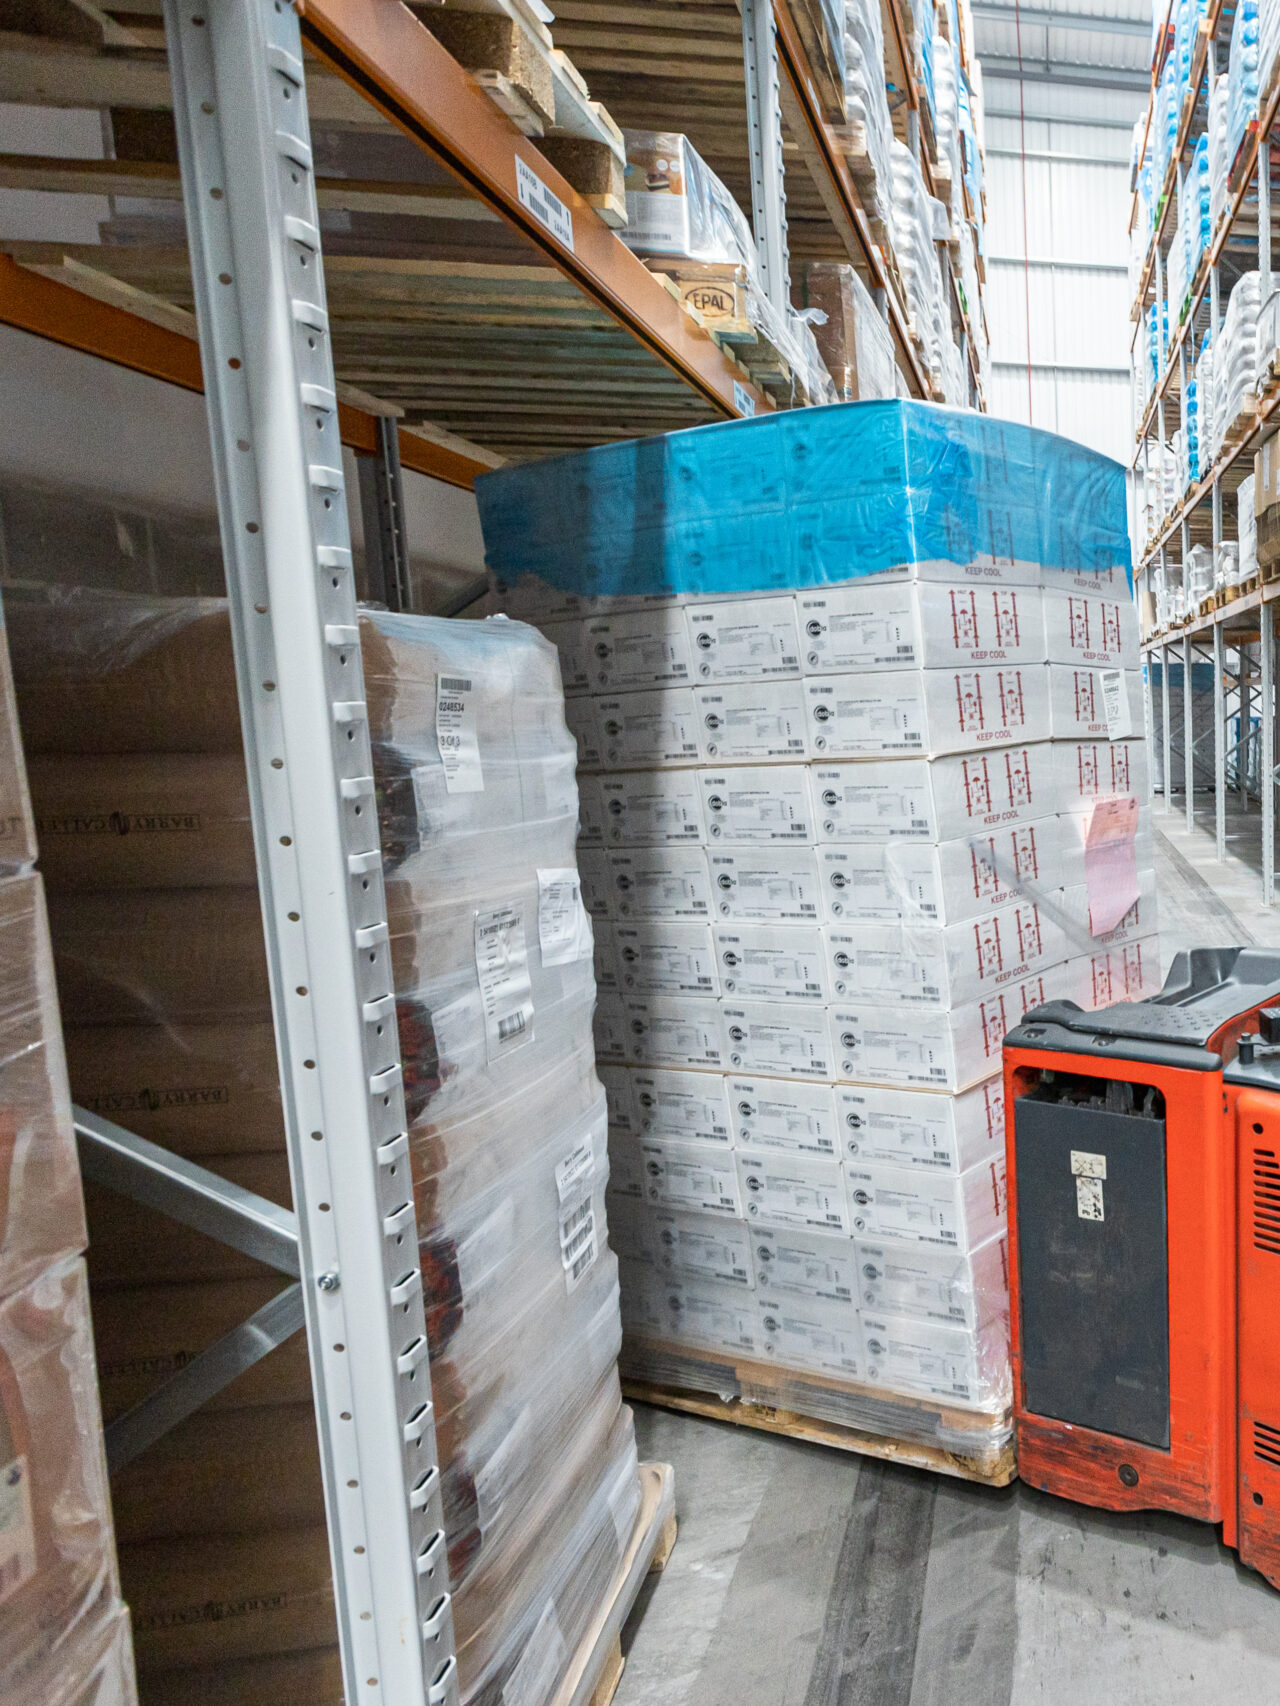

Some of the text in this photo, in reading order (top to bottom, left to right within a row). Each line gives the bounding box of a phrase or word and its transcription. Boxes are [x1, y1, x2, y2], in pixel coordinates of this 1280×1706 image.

[693, 292, 727, 309] EPAL
[965, 567, 1002, 577] KEEP COOL
[1074, 578, 1102, 590] KEEP COOL
[971, 650, 1007, 660] KEEP COOL
[1083, 652, 1111, 661] KEEP COOL
[1088, 724, 1101, 732] KEEP
[976, 730, 1012, 741] KEEP COOL
[984, 810, 1019, 826] KEEP COOL
[991, 892, 1008, 904] KEEP
[994, 964, 1030, 984] KEEP COOL
